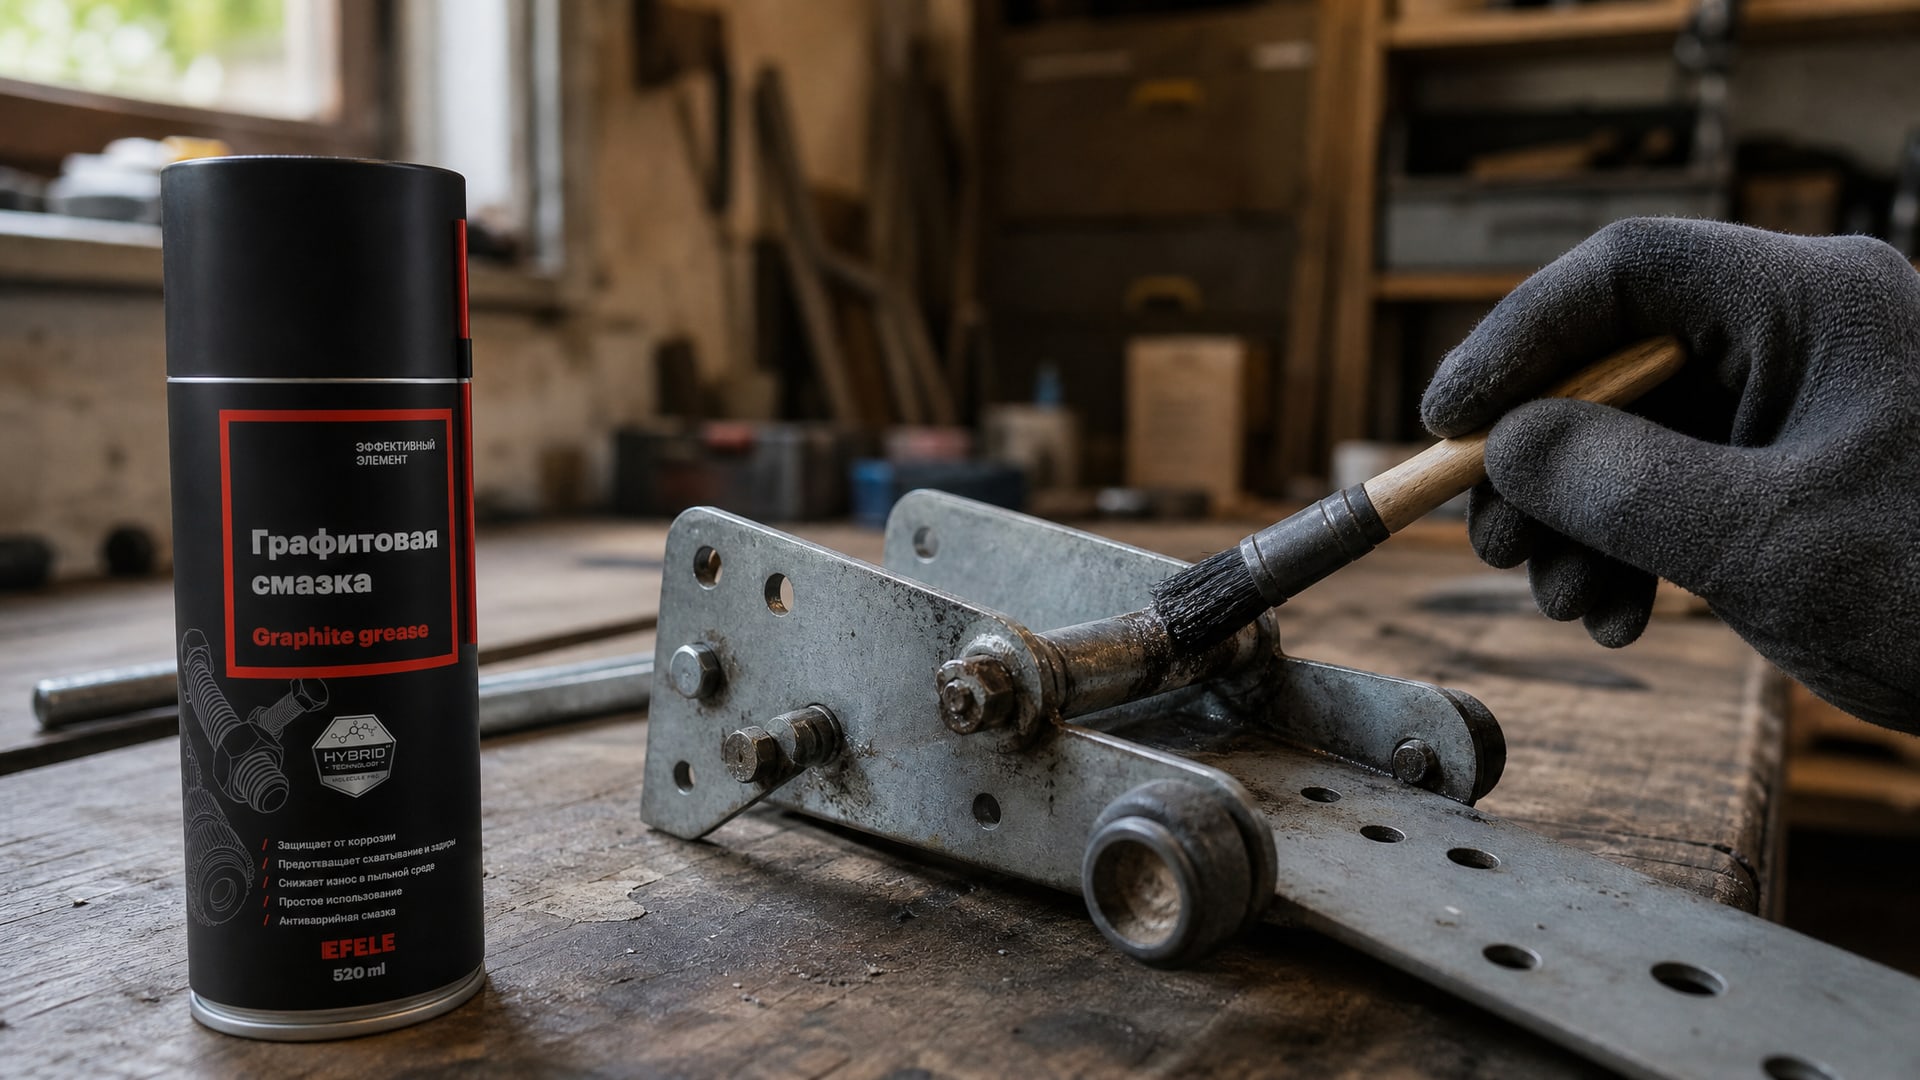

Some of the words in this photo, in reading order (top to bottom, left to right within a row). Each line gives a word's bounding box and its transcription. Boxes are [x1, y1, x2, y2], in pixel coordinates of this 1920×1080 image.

[355, 438, 436, 453] ЭФФЕКТИВНЫЙ
[356, 455, 408, 466] ЭЛЕМЕНТ
[251, 527, 438, 561] Графитовая
[251, 572, 372, 596] смазка
[252, 626, 354, 651] Graphite
[358, 624, 429, 648] grease
[324, 747, 386, 763] HYBRID
[277, 840, 332, 851] Защищает
[333, 838, 346, 848] от
[348, 832, 397, 848] коррозии
[362, 847, 423, 864] схватывание
[424, 845, 430, 854] и
[278, 878, 324, 888] Снижает
[326, 876, 358, 887] износ
[359, 874, 366, 883] в
[367, 867, 409, 882] пыльной
[410, 862, 436, 876] среде
[278, 896, 324, 909] Простое
[326, 887, 403, 905] использование
[361, 907, 397, 920] смазка
[321, 932, 396, 960] EFELE
[333, 966, 365, 982] 520
[367, 962, 386, 978] ml
